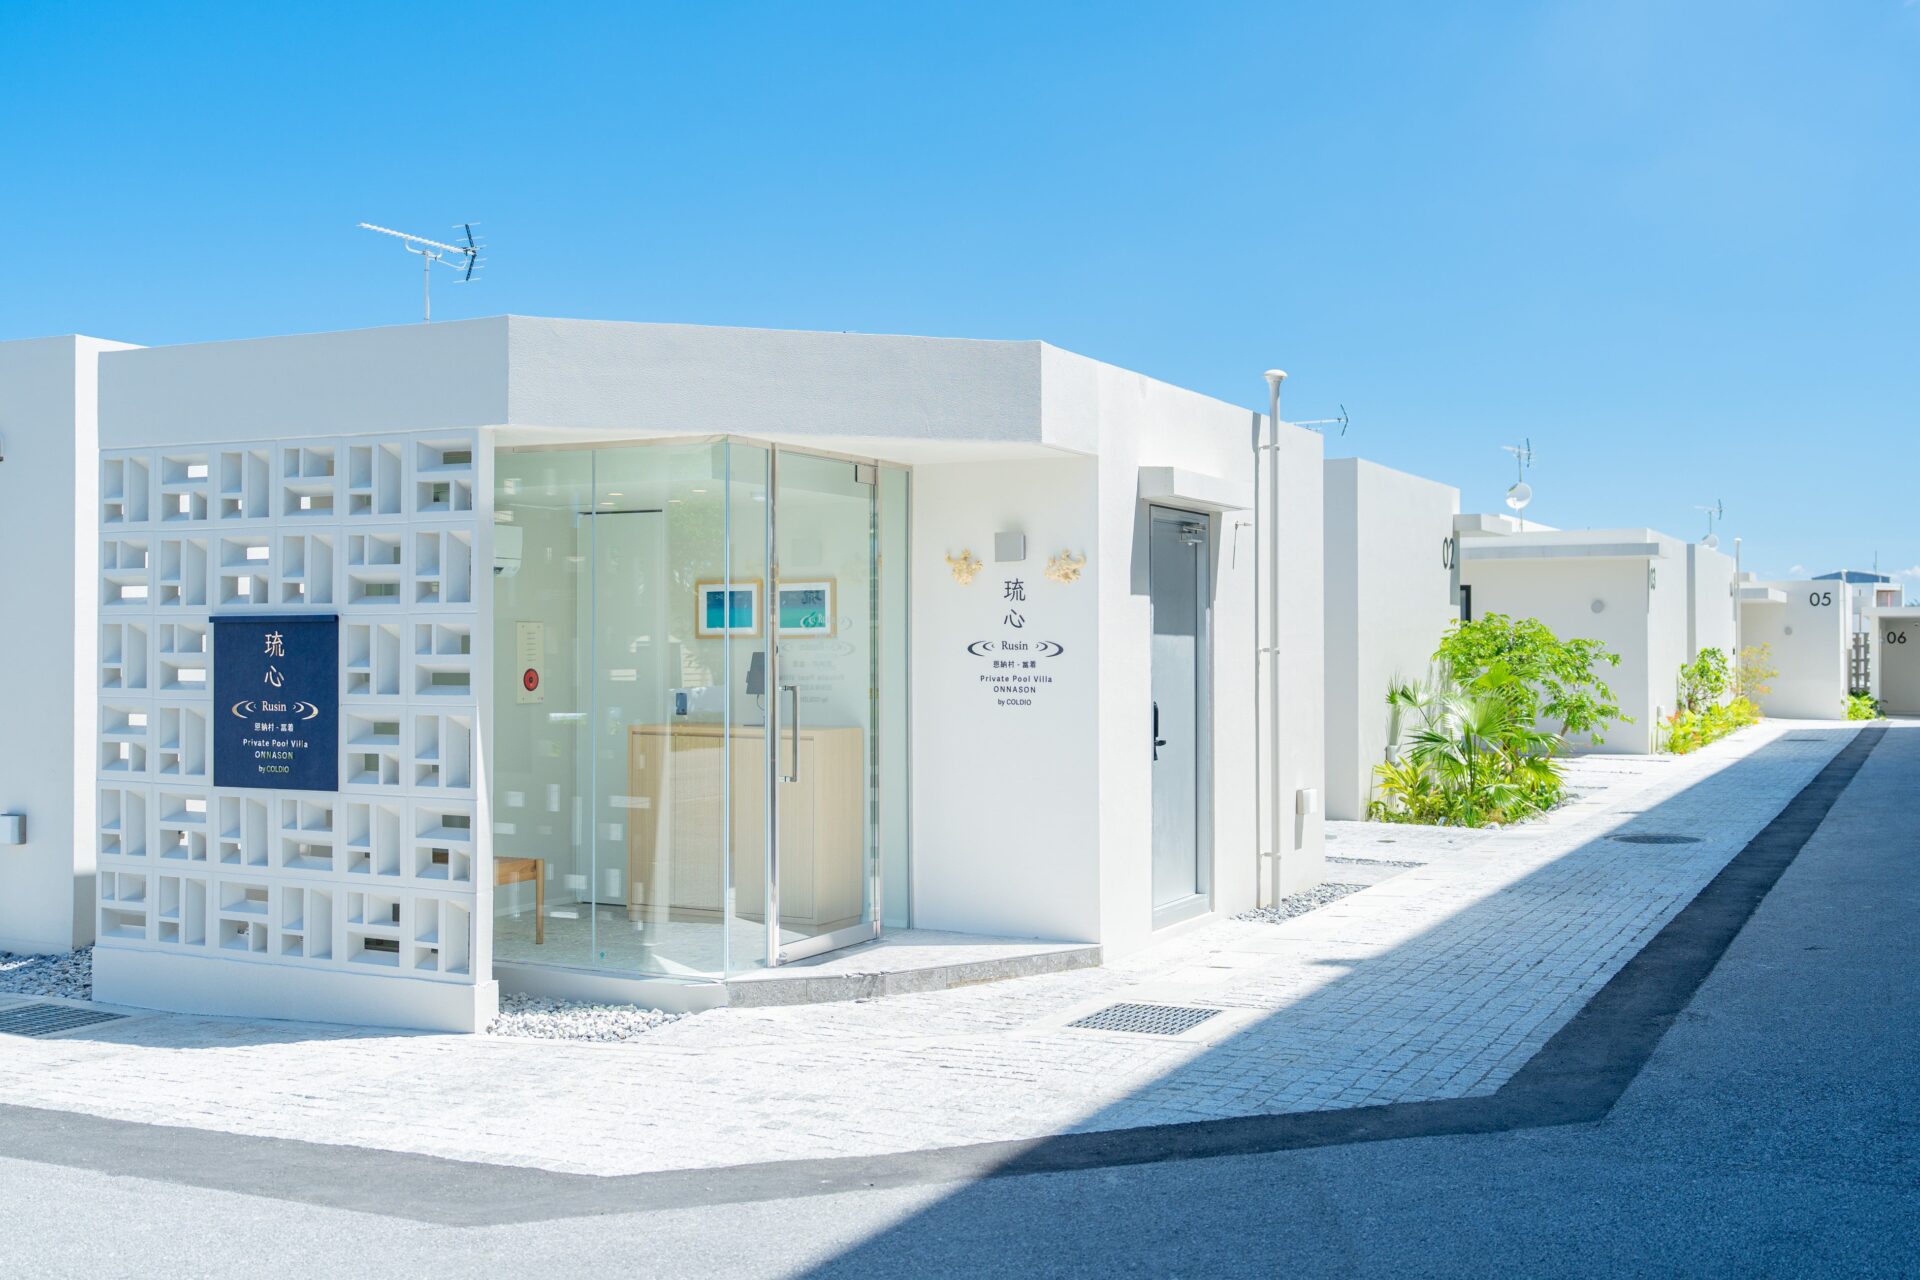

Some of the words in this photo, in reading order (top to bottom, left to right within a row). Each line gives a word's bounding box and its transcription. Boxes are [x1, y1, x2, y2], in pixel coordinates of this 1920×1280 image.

[1442, 536, 1455, 570] 02
[1003, 577, 1026, 629] 琉心
[1809, 592, 1831, 606] 05
[1886, 631, 1907, 644] 06
[1001, 640, 1028, 650] Rusin
[264, 630, 285, 687] 琉心
[1034, 675, 1052, 683] Villa
[993, 685, 1036, 693] ONNASON
[262, 700, 287, 712] Rusin
[242, 738, 270, 747] Private
[272, 739, 289, 747] Pool
[290, 740, 308, 748] Villa
[254, 750, 294, 760] ONNASON
[258, 765, 266, 774] by
[266, 765, 290, 773] COLDIO
